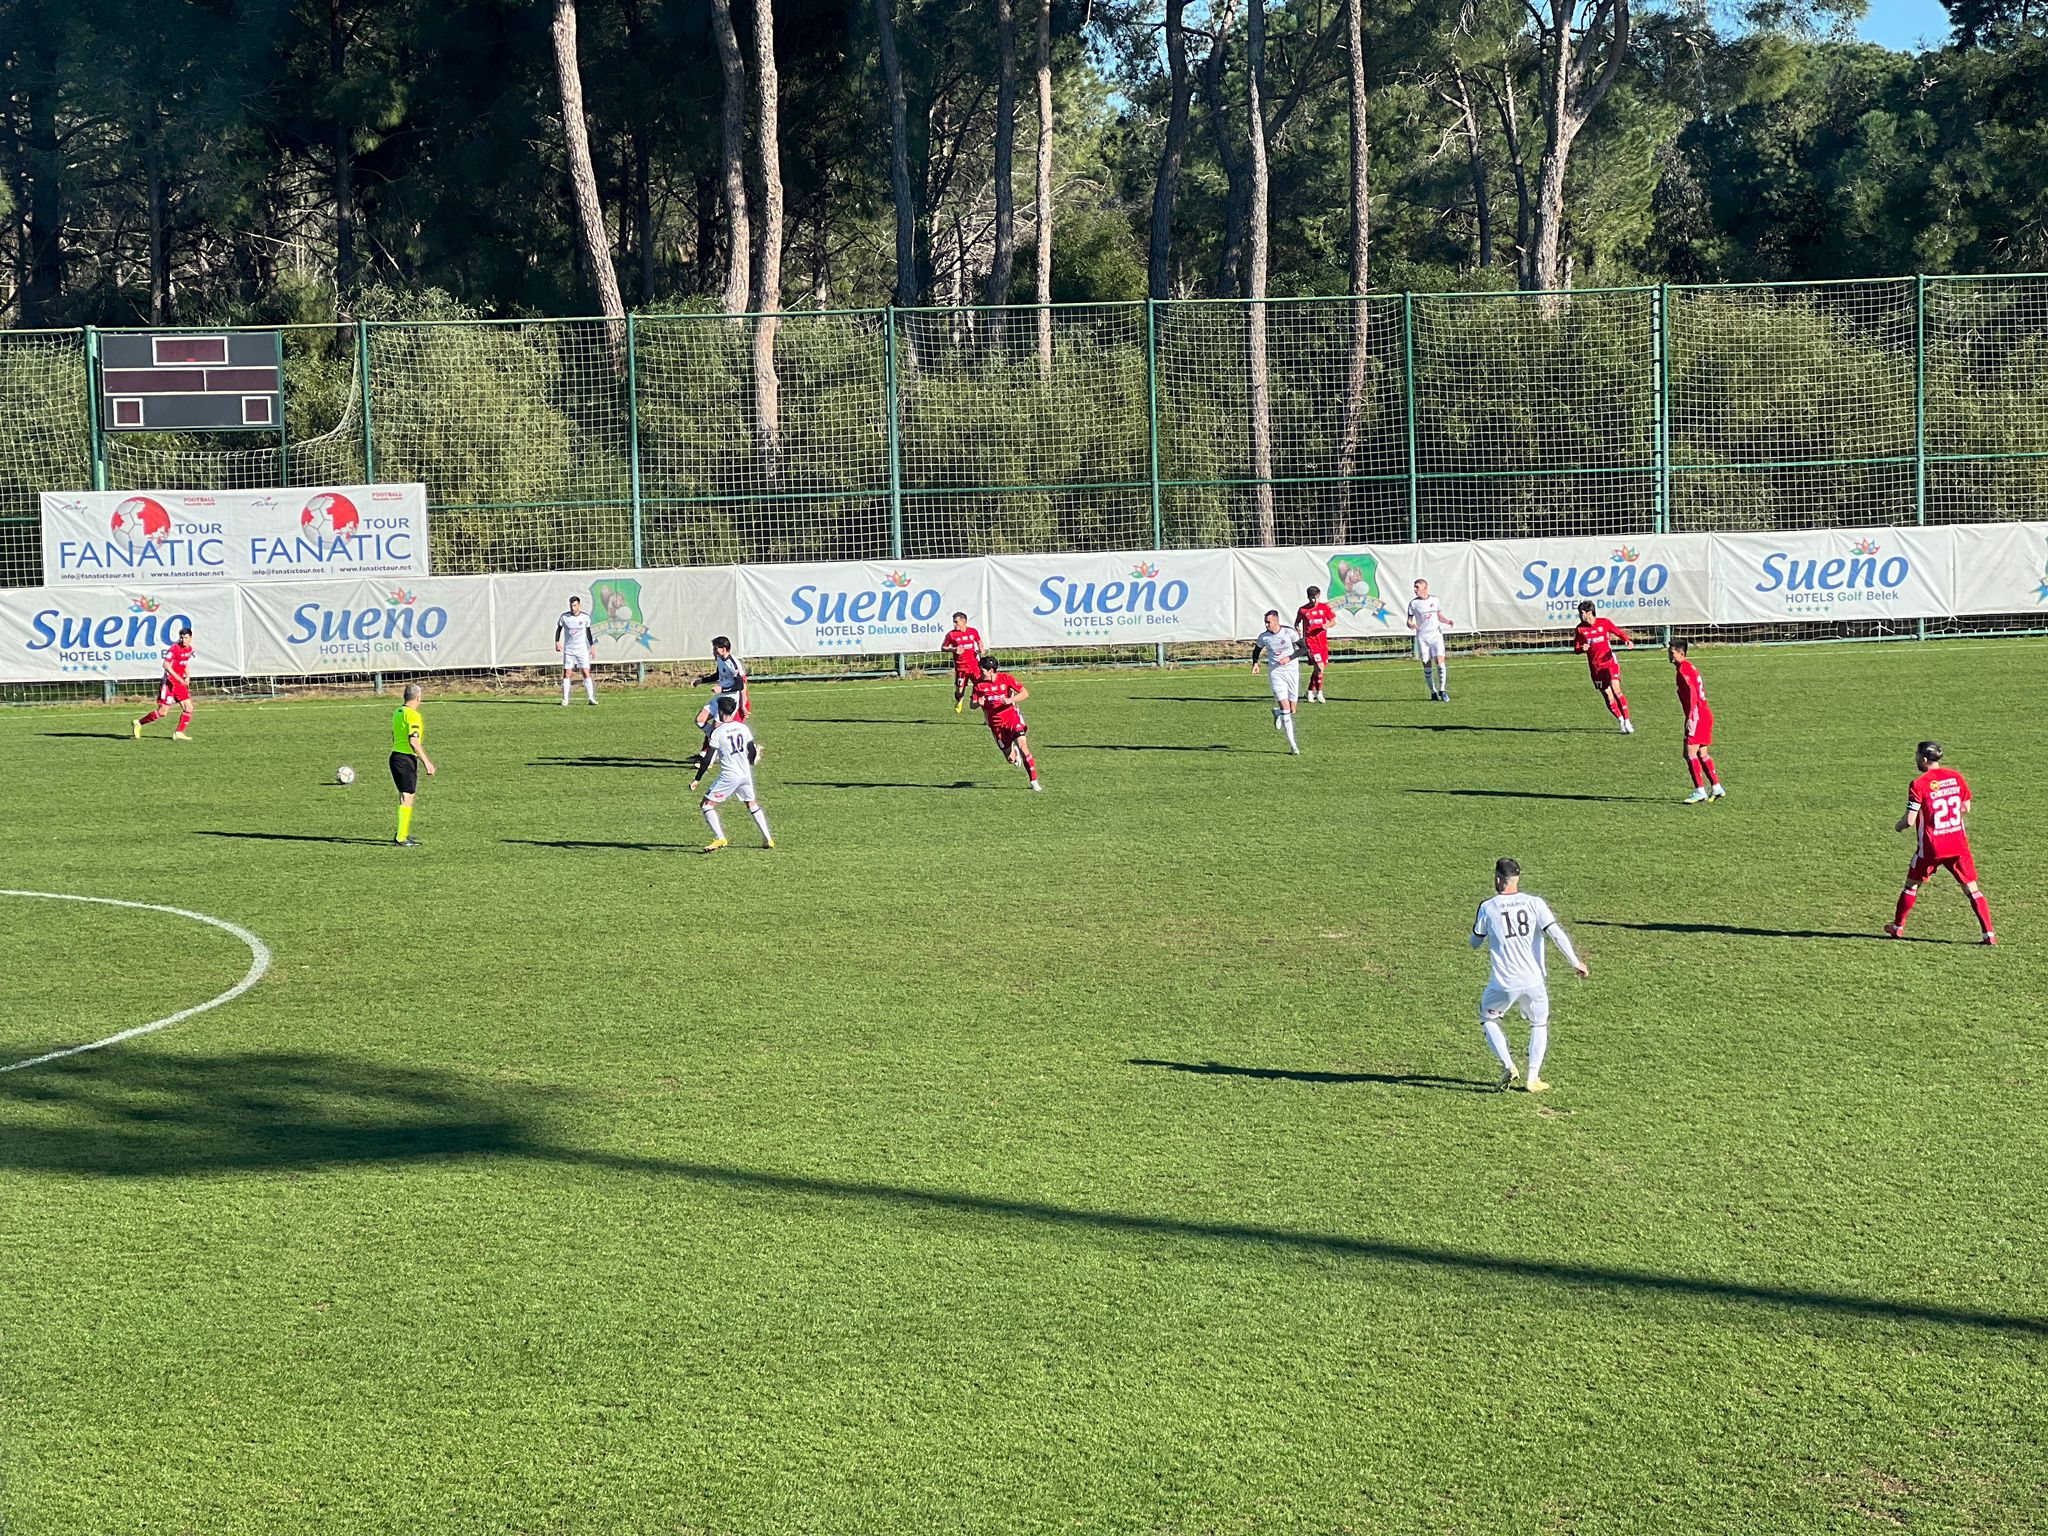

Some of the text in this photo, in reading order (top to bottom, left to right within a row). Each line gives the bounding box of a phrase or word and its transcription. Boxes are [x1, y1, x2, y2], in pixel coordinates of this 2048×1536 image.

[175, 523, 223, 535] TOUR
[363, 518, 410, 529] TOUR
[59, 538, 225, 569] FANATIC
[251, 533, 412, 565] FANATIC
[60, 570, 225, 580] info@fanatictour.net www.fanatictour.net
[251, 564, 412, 576] info@fanatictour.net www.fanatictour.net
[1546, 597, 1671, 611] HOTE Deluxe Belek
[1785, 590, 1900, 604] HOTELS Golf Belek
[1063, 613, 1180, 627] HOTELS Golf Belek
[815, 622, 944, 637] HOTELS Deluxe Belek
[319, 640, 438, 655] HOTELS Golf Belek
[59, 651, 112, 662] HOTELS
[114, 650, 158, 661] Deluxe
[726, 733, 744, 756] 10
[1931, 795, 1962, 830] 23
[1500, 909, 1530, 939] 18
